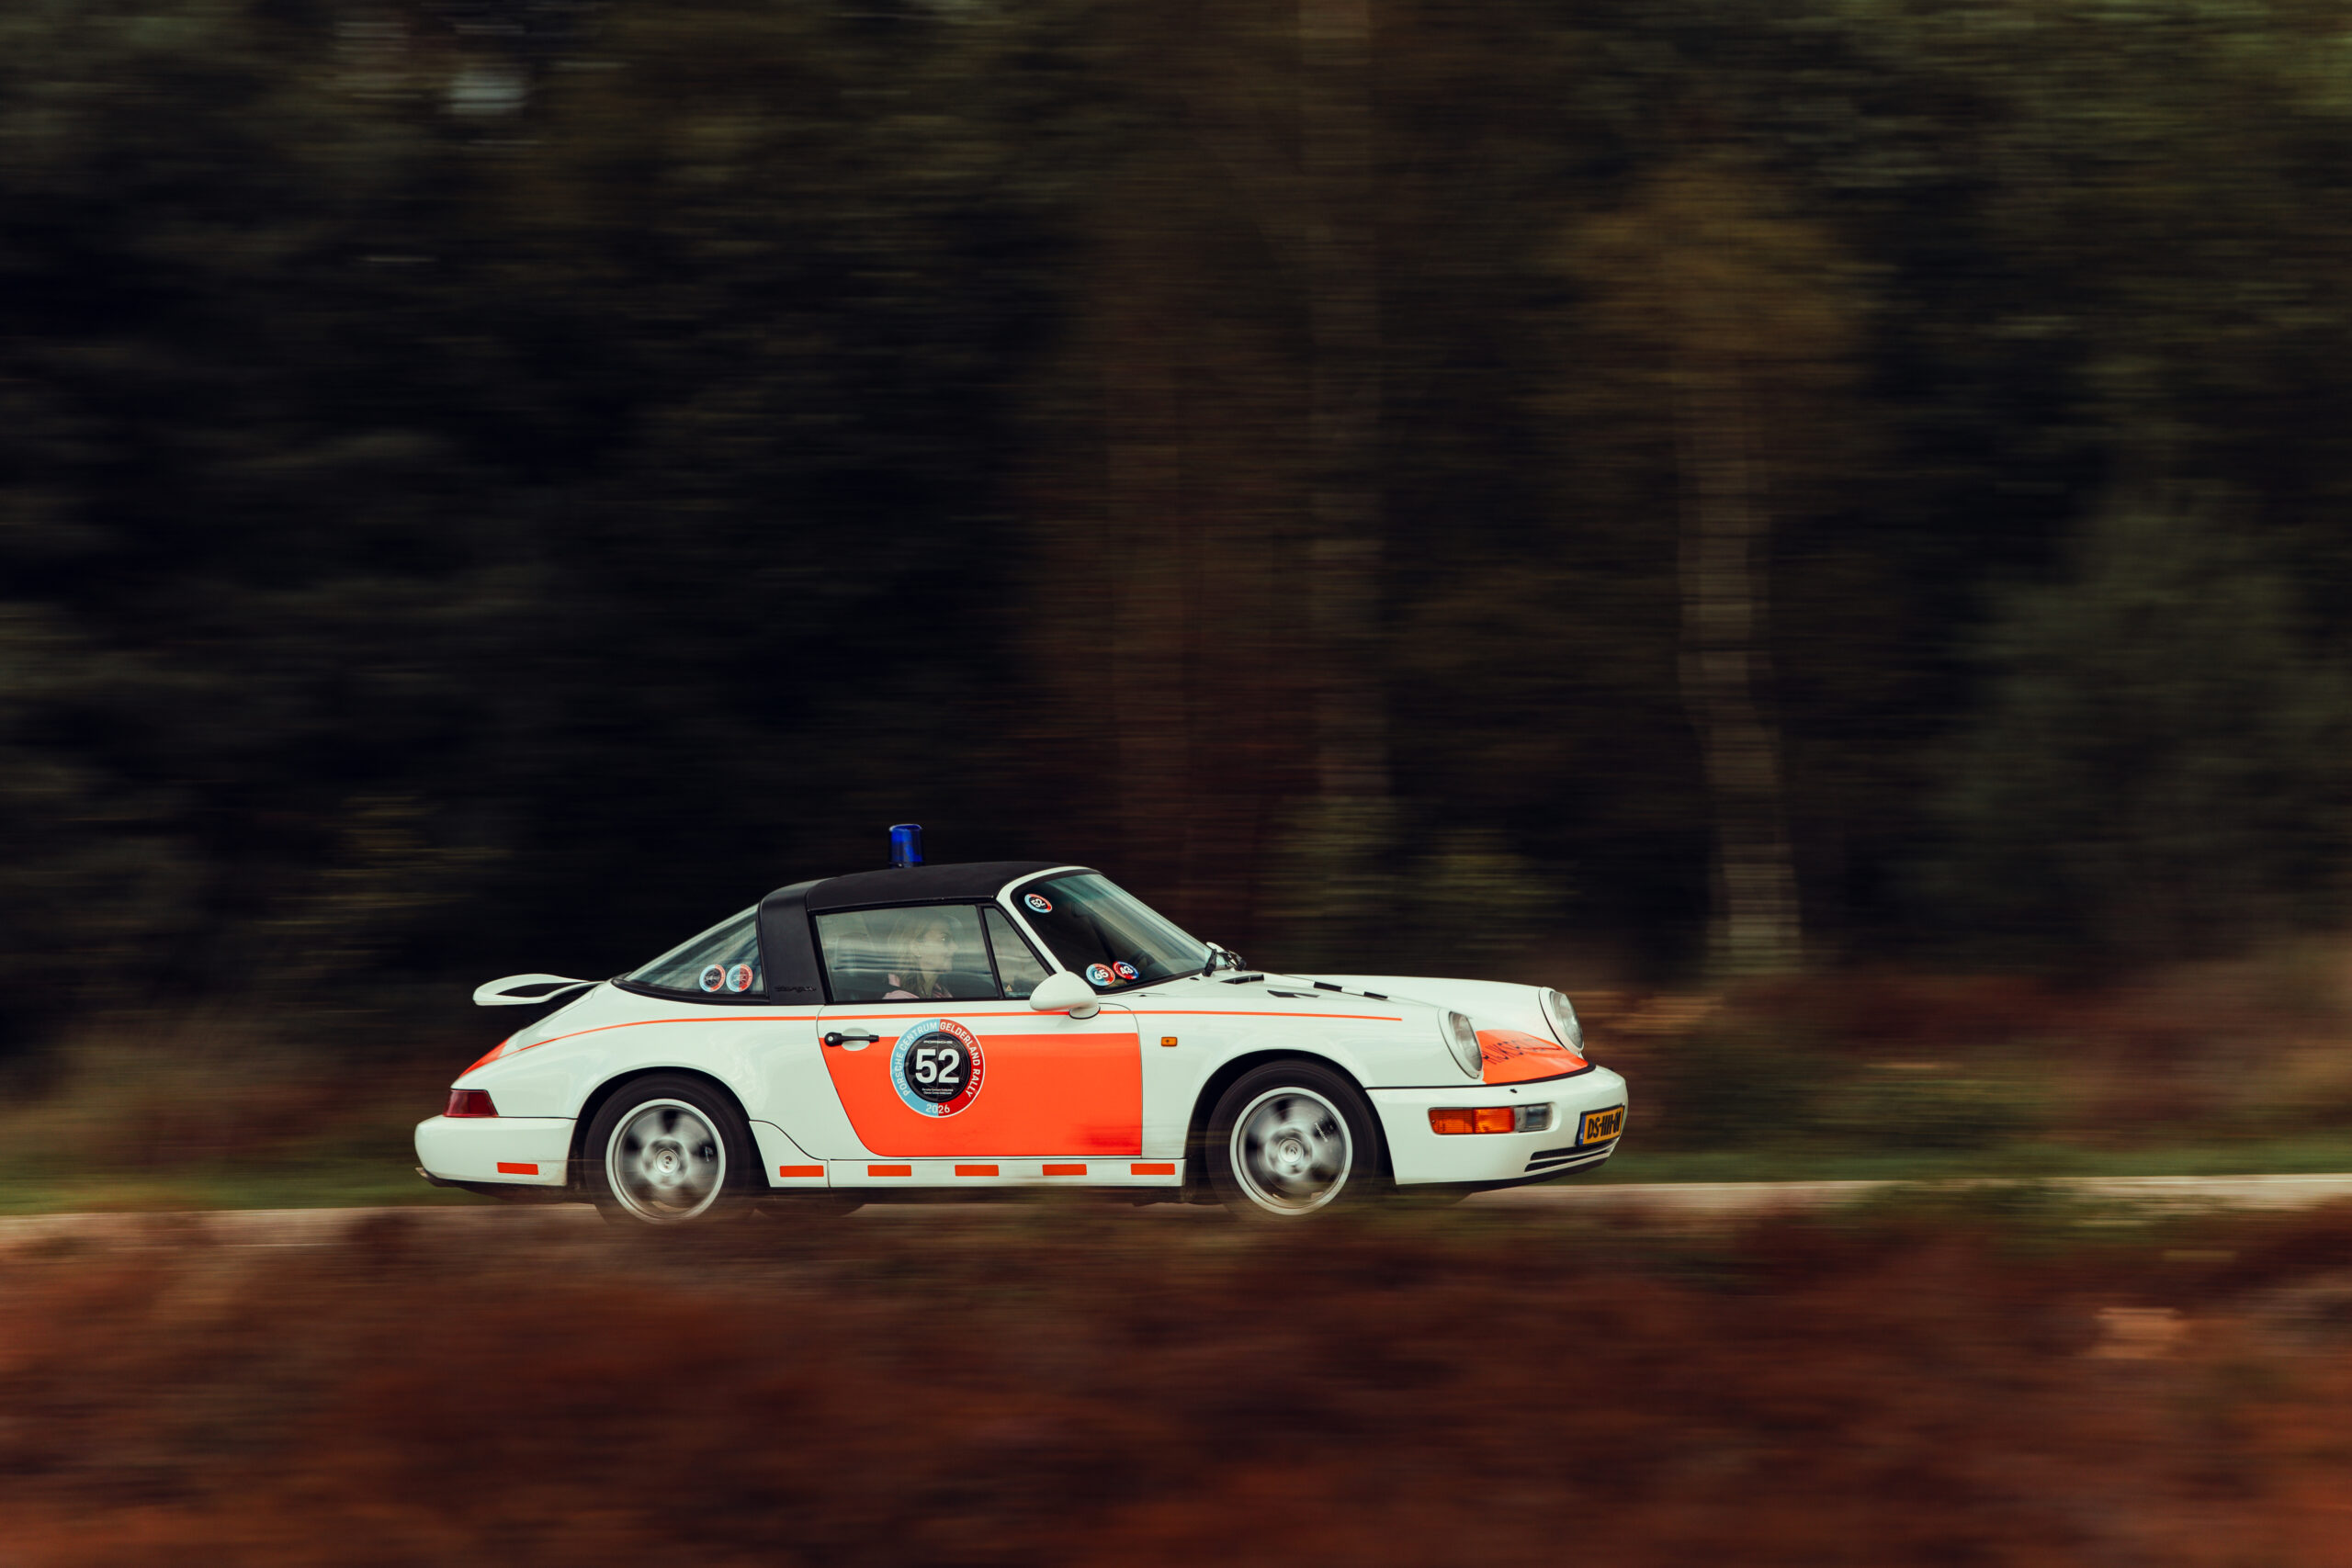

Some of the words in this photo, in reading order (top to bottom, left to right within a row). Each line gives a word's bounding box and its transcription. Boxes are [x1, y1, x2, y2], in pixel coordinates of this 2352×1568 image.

[1031, 898, 1046, 908] 52
[1094, 969, 1109, 980] 65
[1120, 965, 1133, 975] 43
[899, 1021, 937, 1051] CENTRUM
[915, 1048, 960, 1084] 52
[940, 1021, 980, 1066] GELDERLAND
[965, 1068, 980, 1098] RALLY
[894, 1052, 910, 1097] PORSCHE
[925, 1104, 950, 1114] 2026
